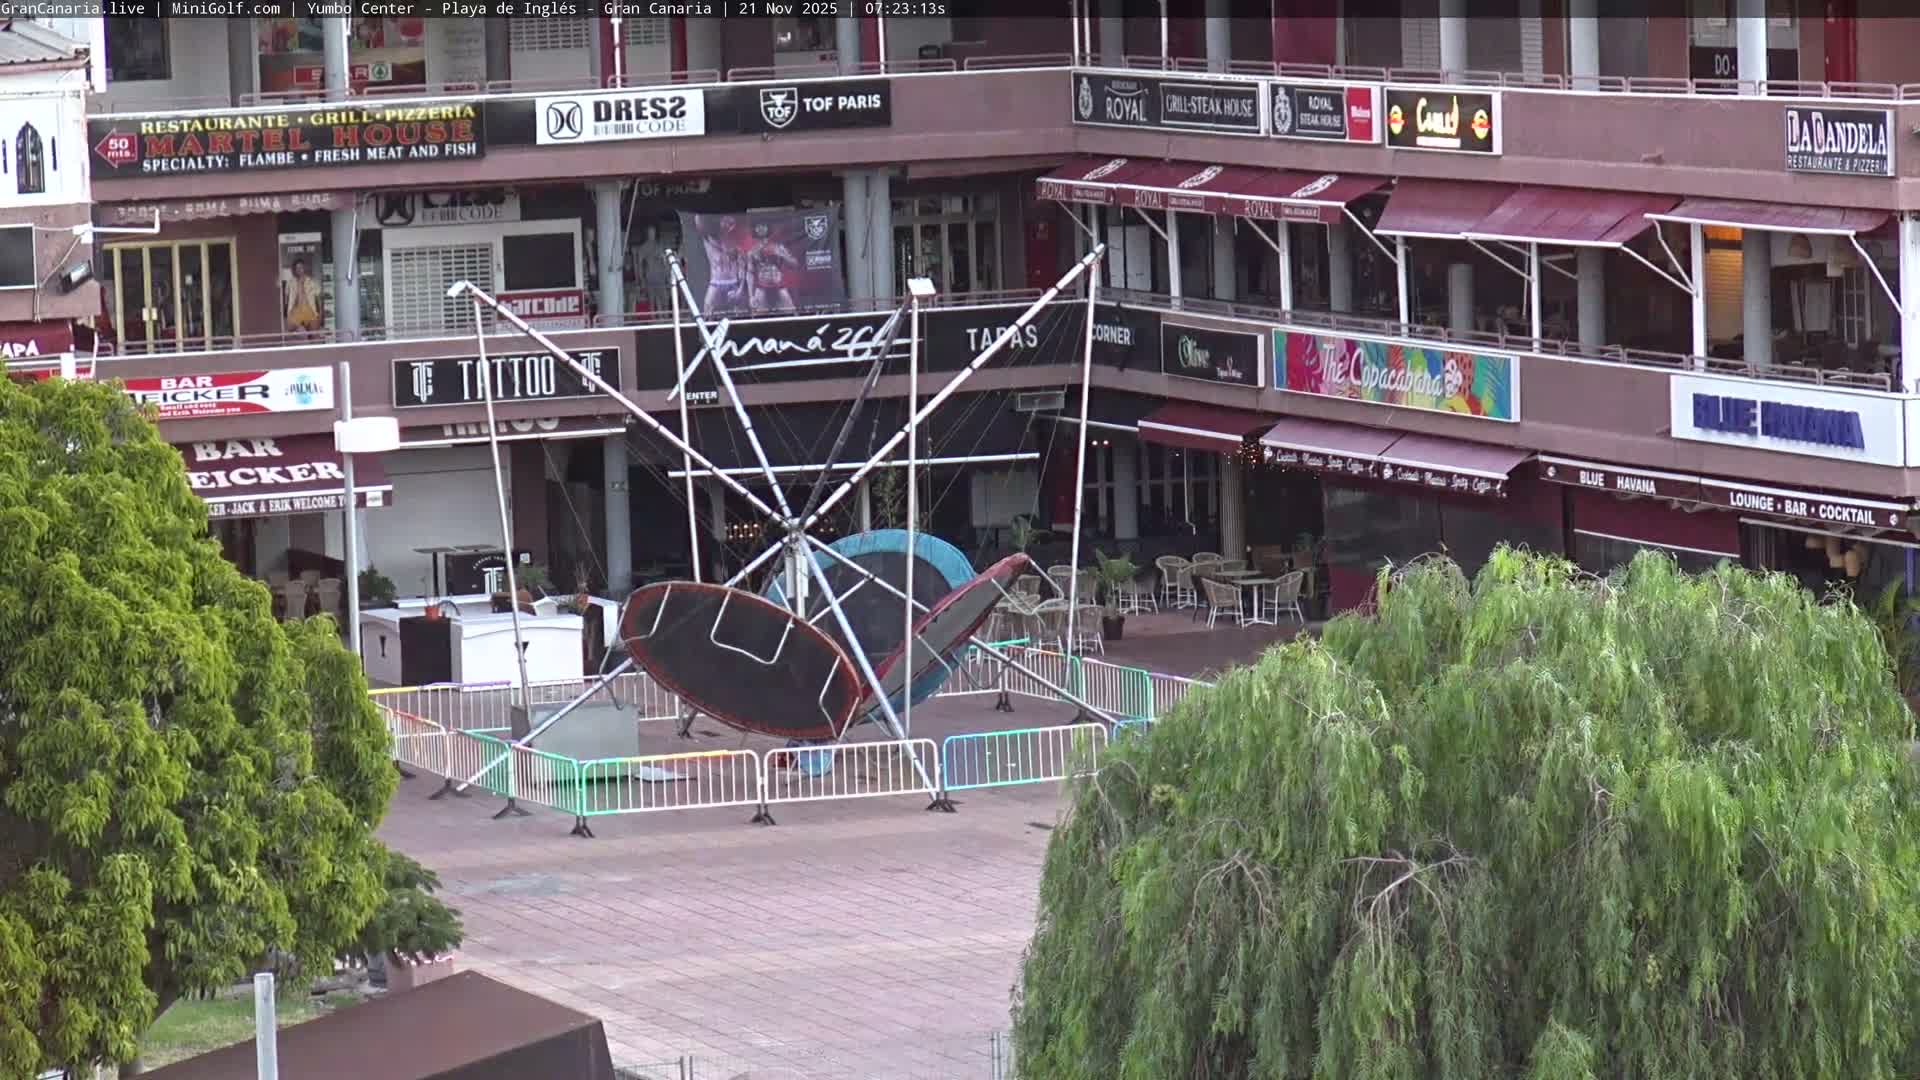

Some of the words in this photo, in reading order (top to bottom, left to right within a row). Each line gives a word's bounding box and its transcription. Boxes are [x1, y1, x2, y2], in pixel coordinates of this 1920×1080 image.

[767, 106, 792, 119] TOF
[803, 97, 833, 112] TOF
[838, 94, 881, 110] PARIS
[1106, 96, 1148, 121] ROYAL
[1166, 94, 1223, 115] GRILL-STEAK
[1223, 98, 1254, 117] HOUSE
[1308, 95, 1334, 111] ROYAL
[141, 115, 289, 134] RESTAURANTE
[310, 110, 373, 126] GRILL
[385, 105, 475, 122] PIZZERIA
[636, 118, 687, 134] CODE
[1300, 112, 1320, 126] STEAK
[1321, 113, 1342, 128] HOUSE
[108, 138, 129, 149] 50
[145, 127, 311, 158] MARTEL
[332, 119, 475, 148] HOUSE
[142, 156, 229, 173] SPECIALTY:
[239, 151, 295, 168] FLAMBE
[314, 148, 360, 163] FRESH
[367, 146, 406, 161] MEAT
[409, 144, 439, 158] AND
[445, 142, 477, 157] FISH
[1788, 154, 1842, 170] RESTAURANTE
[1852, 159, 1888, 173] PIZZERIA
[1134, 190, 1162, 208] ROYAL
[1245, 200, 1276, 218] ROYAL
[1091, 323, 1131, 345] CORNER
[0, 339, 40, 358] APA
[457, 356, 556, 400] TATTOO
[1321, 343, 1347, 384] The
[1350, 348, 1443, 396] Copacabana
[161, 376, 213, 390] BAR
[686, 390, 718, 401] ENTER
[193, 438, 284, 462] BAR
[187, 461, 345, 489] EICKER
[1579, 470, 1605, 487] BLUE
[1616, 475, 1657, 494] HAVANA
[231, 500, 256, 515] JACK
[269, 498, 292, 513] ERIK
[293, 495, 337, 510] WELCOME
[1730, 491, 1774, 512] LOUNGE
[1785, 500, 1807, 517] BAR
[1819, 504, 1876, 525] COCKTAIL
